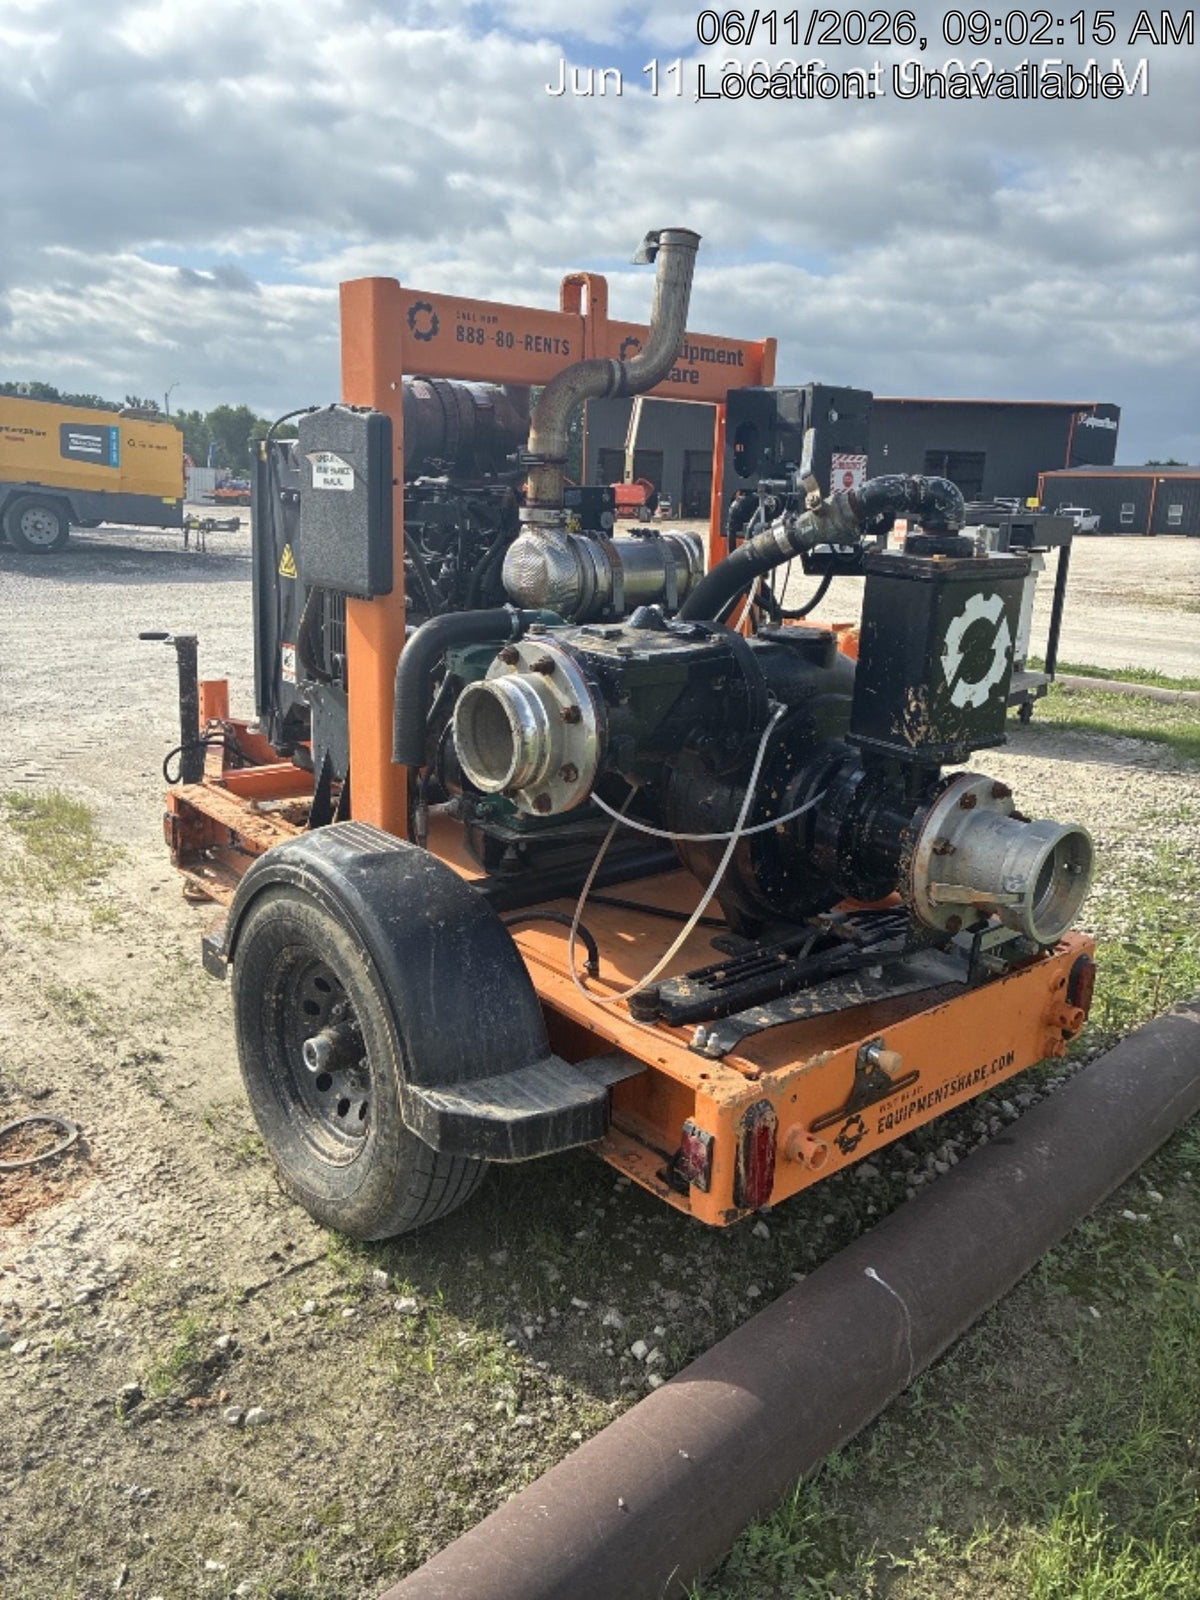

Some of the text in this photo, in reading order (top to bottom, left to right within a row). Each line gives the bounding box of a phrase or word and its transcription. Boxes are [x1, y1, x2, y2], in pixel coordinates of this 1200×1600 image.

[456, 324, 570, 356] 888-80-RENTS
[680, 340, 744, 367] ipment
[667, 367, 700, 384] are
[877, 1050, 1015, 1134] EQUIPMENTSHARE.COM
